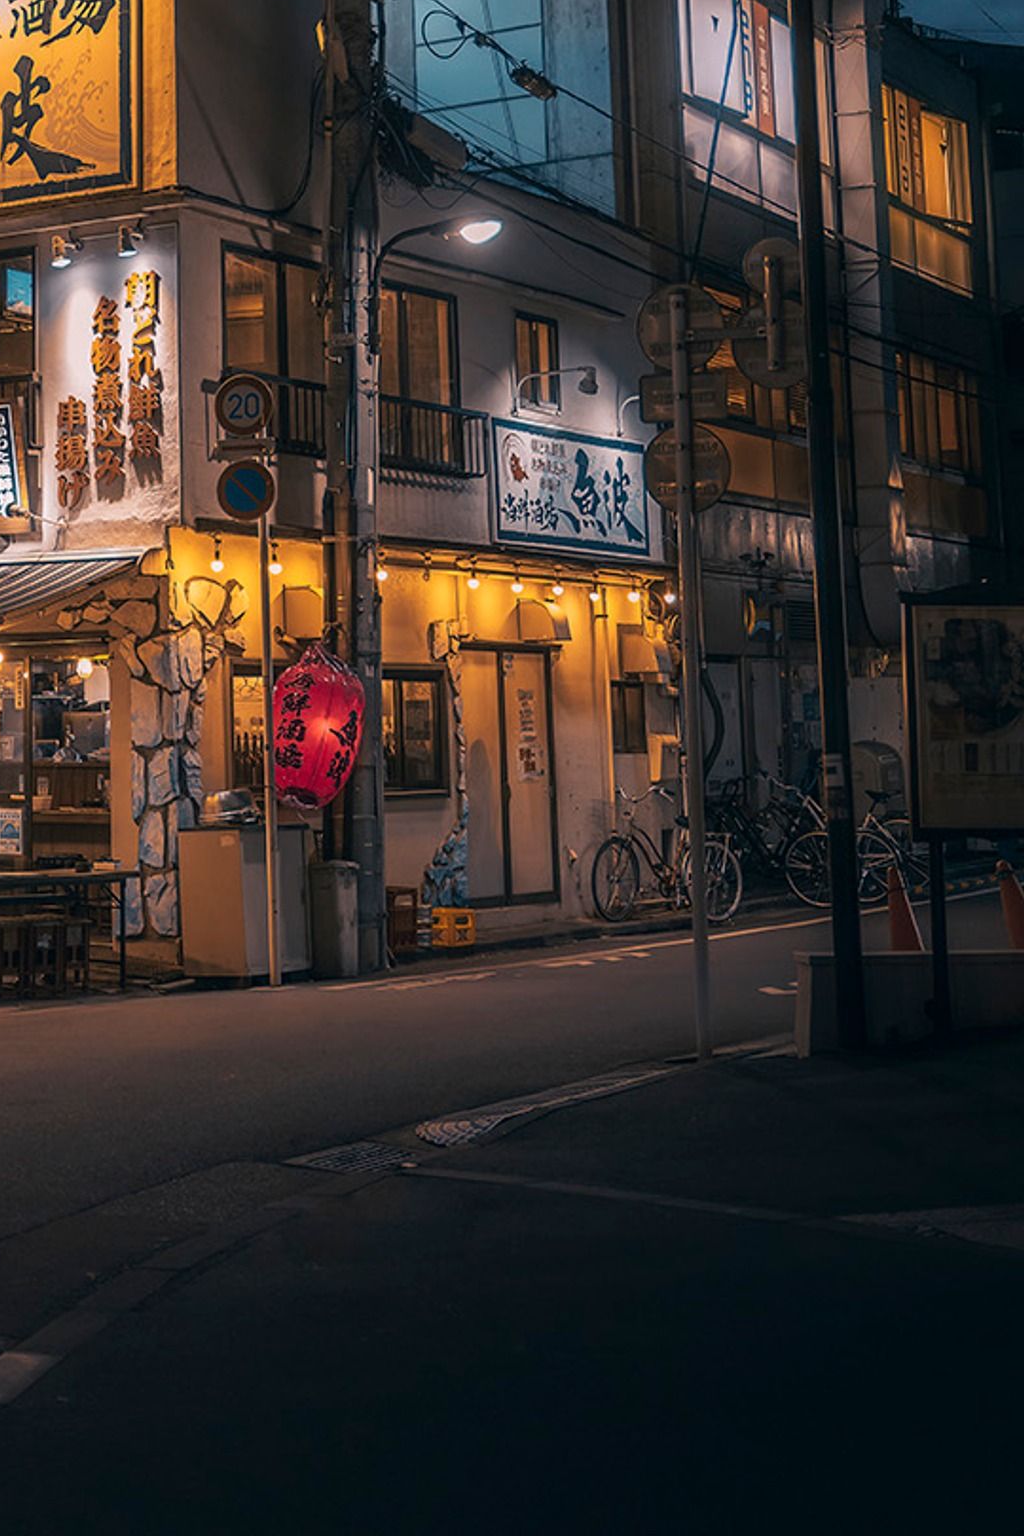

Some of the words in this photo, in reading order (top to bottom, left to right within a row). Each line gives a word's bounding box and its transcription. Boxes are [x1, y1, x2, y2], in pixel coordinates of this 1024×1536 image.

[91, 296, 126, 486] 名物煮込み
[227, 391, 260, 421] 20
[55, 395, 91, 511] 串揚げ
[558, 448, 646, 543] 魚波
